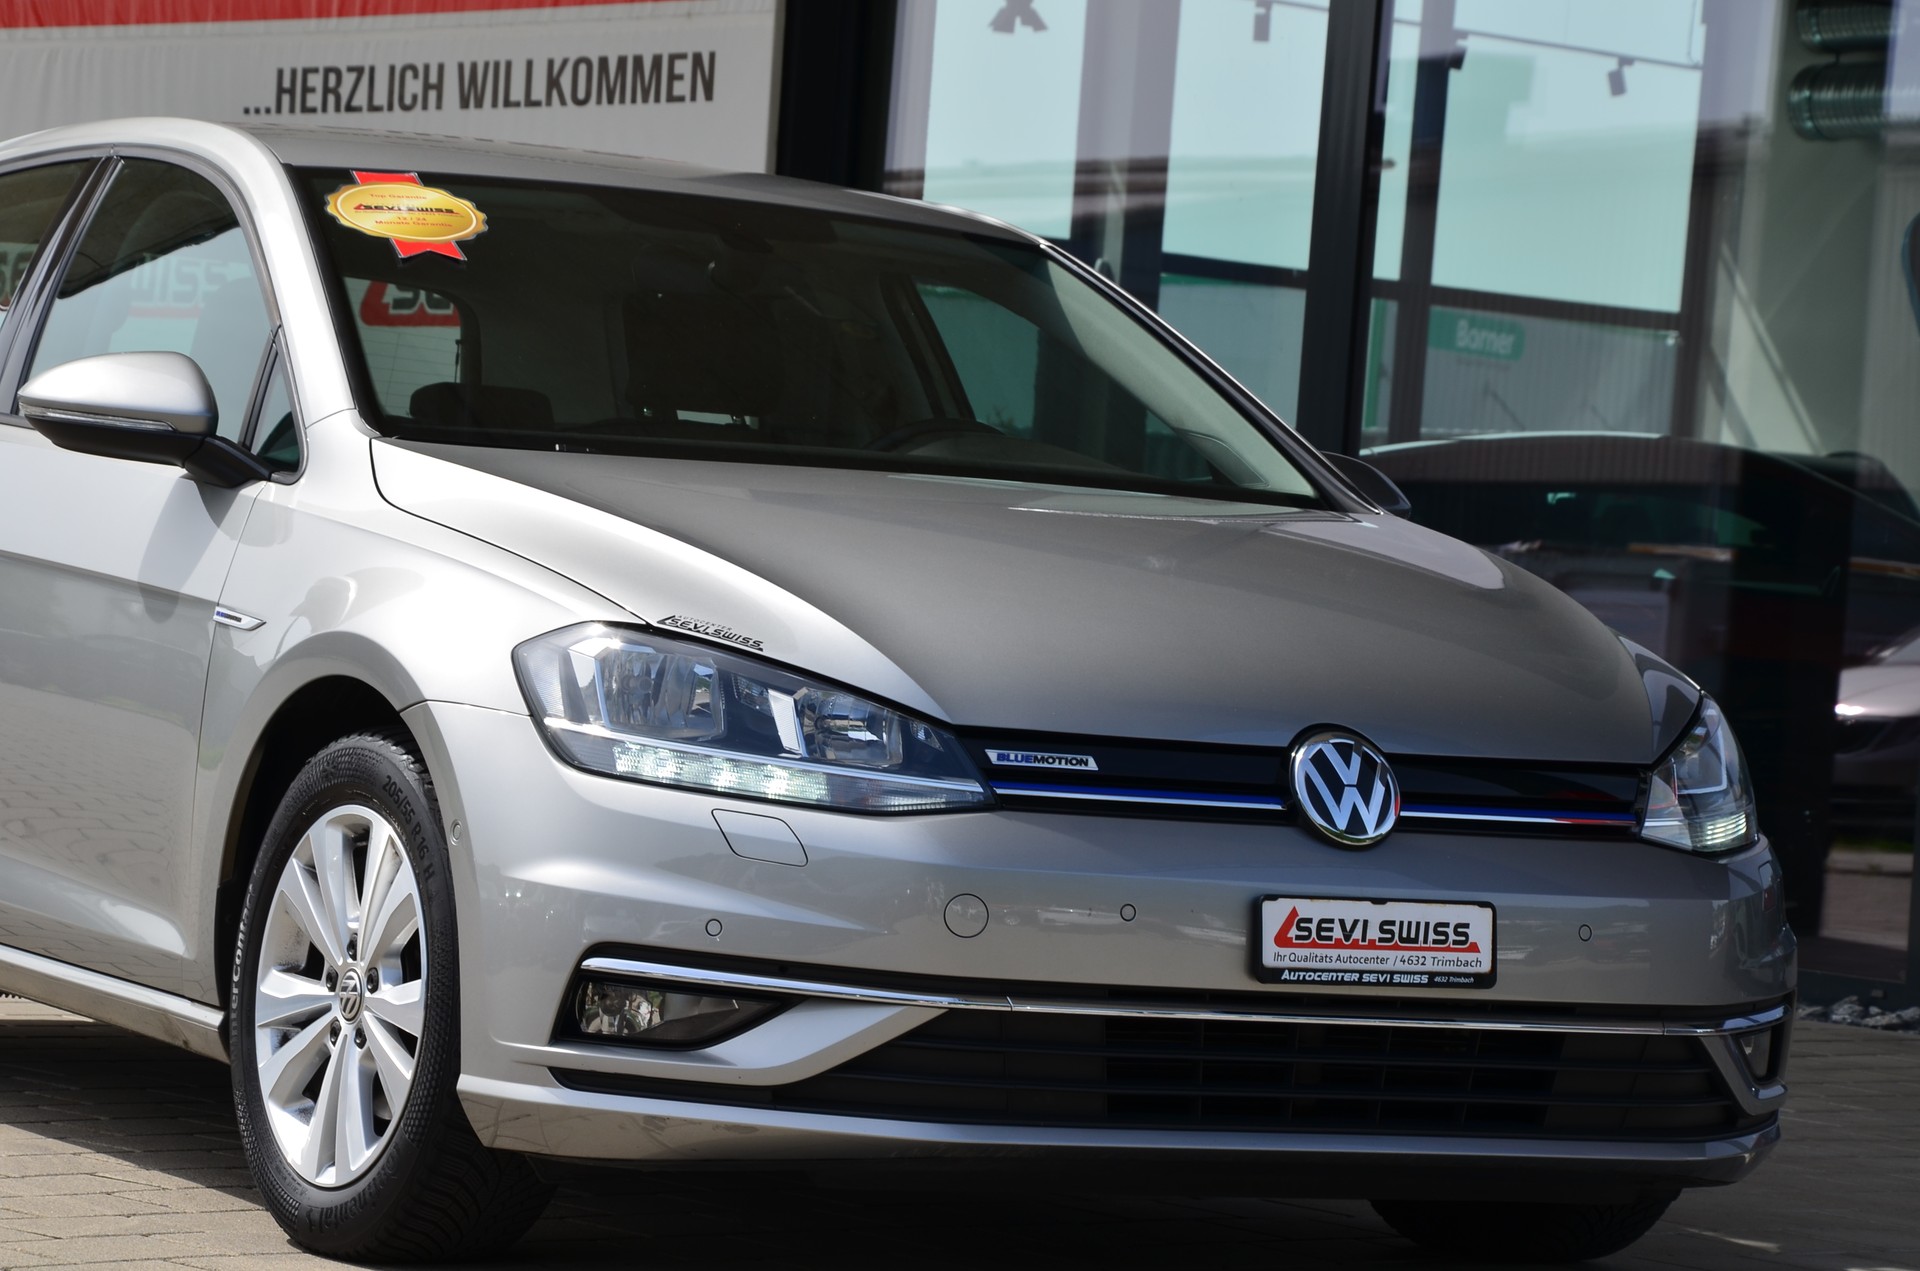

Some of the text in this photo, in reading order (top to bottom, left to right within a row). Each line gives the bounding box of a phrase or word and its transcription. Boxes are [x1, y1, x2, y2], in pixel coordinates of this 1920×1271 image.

[457, 51, 716, 109] WILLKOMMEN
[996, 752, 1090, 767] BLUEMOTION
[382, 774, 416, 825] 205/55
[1294, 917, 1470, 947] SEVI SWISS
[1273, 952, 1287, 963] Ihr
[1288, 952, 1333, 964] Qualitäts
[1334, 954, 1390, 966] Autocenter
[1400, 955, 1427, 967] 4632
[1430, 956, 1482, 968] Trimbach
[1392, 973, 1429, 984] SWISS
[1449, 976, 1474, 984] Trimbach
